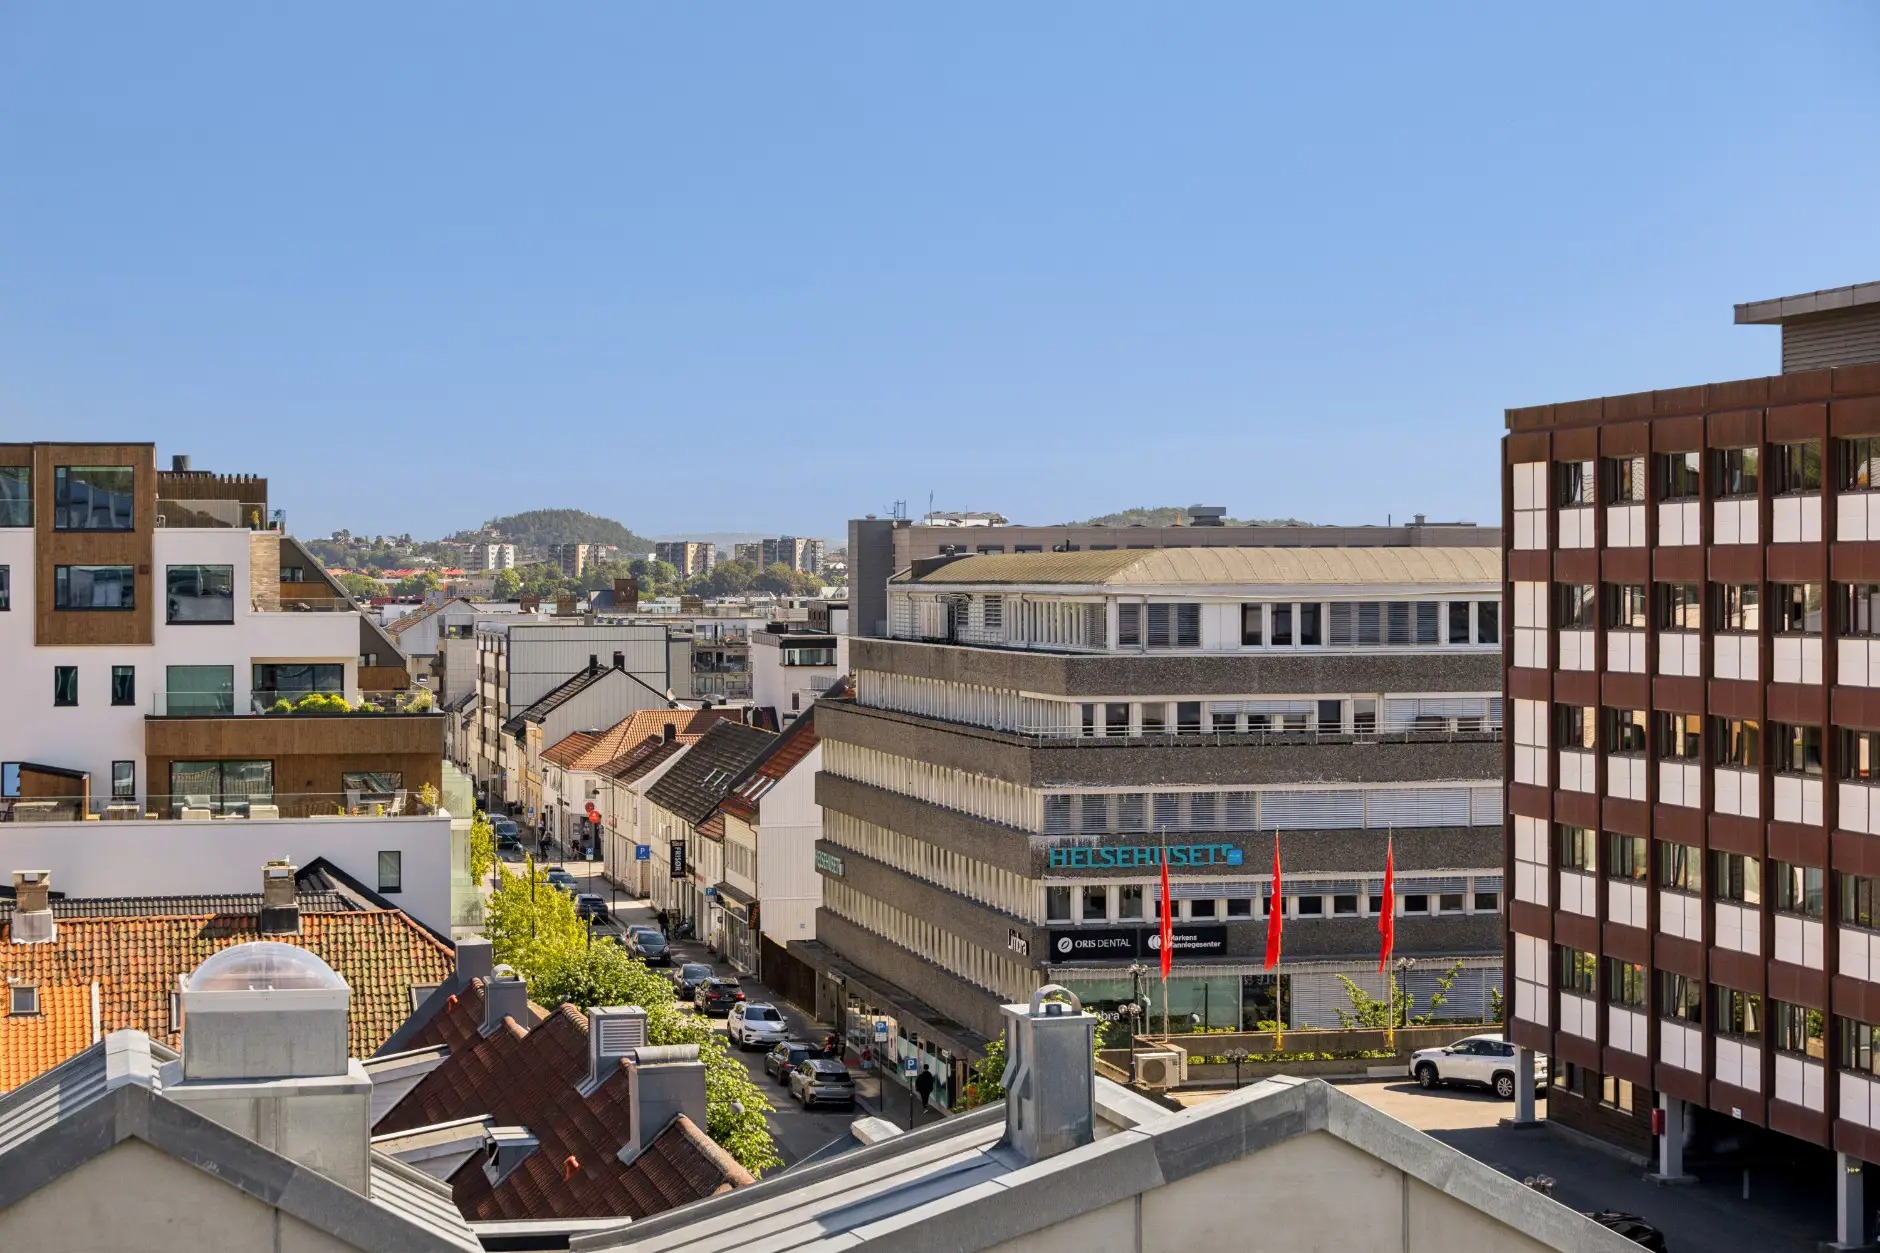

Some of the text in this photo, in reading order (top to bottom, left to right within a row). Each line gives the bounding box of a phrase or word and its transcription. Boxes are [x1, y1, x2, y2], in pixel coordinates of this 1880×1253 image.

[640, 847, 646, 855] P
[1049, 843, 1219, 869] HELSEHUSET
[674, 846, 682, 872] FRISØR
[1075, 938, 1132, 949] ORIS DENTAL
[877, 1022, 884, 1031] P
[907, 1060, 915, 1069] P
